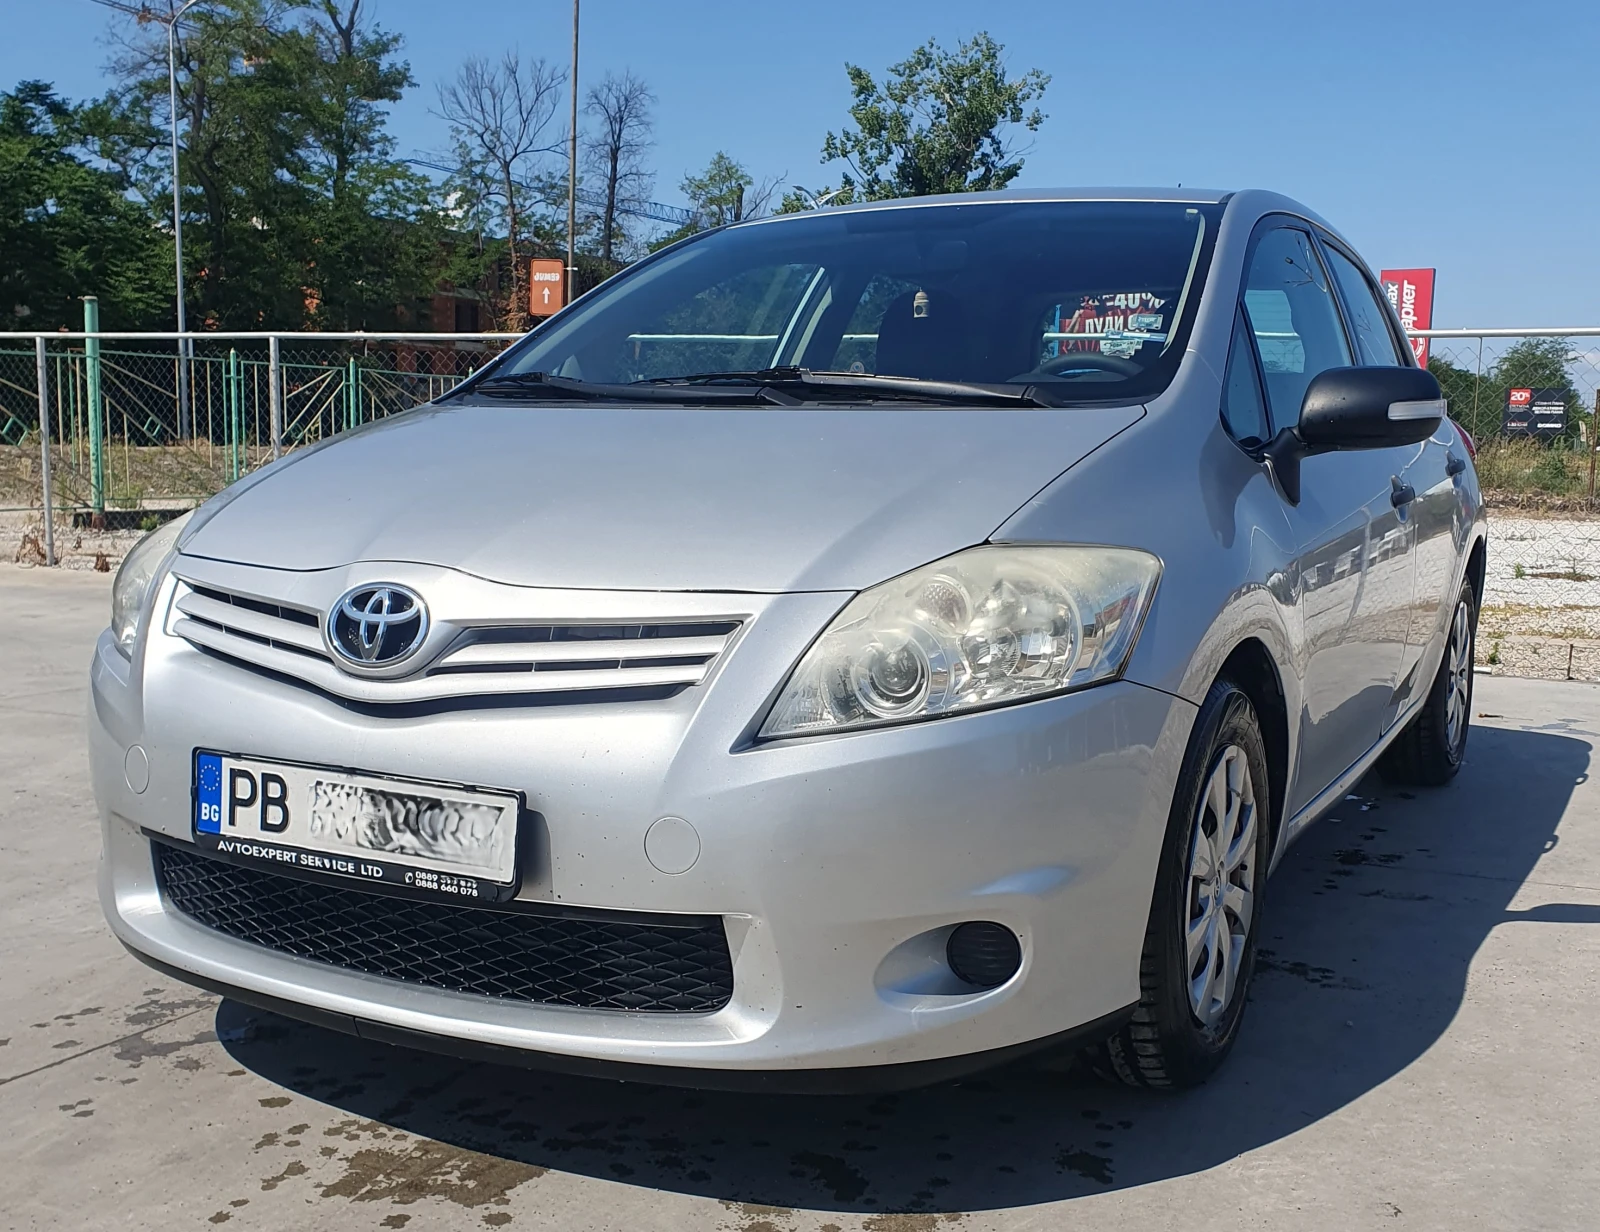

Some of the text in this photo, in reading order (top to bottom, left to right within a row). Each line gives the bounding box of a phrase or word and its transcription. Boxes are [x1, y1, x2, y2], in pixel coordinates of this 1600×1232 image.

[228, 767, 290, 834] PB
[201, 802, 219, 822] BG
[217, 840, 383, 878] AVTOEXPERT SERVICE LTD
[415, 871, 438, 882] 0889
[415, 879, 438, 890] 0888
[440, 884, 458, 893] 660
[460, 887, 478, 897] 078
